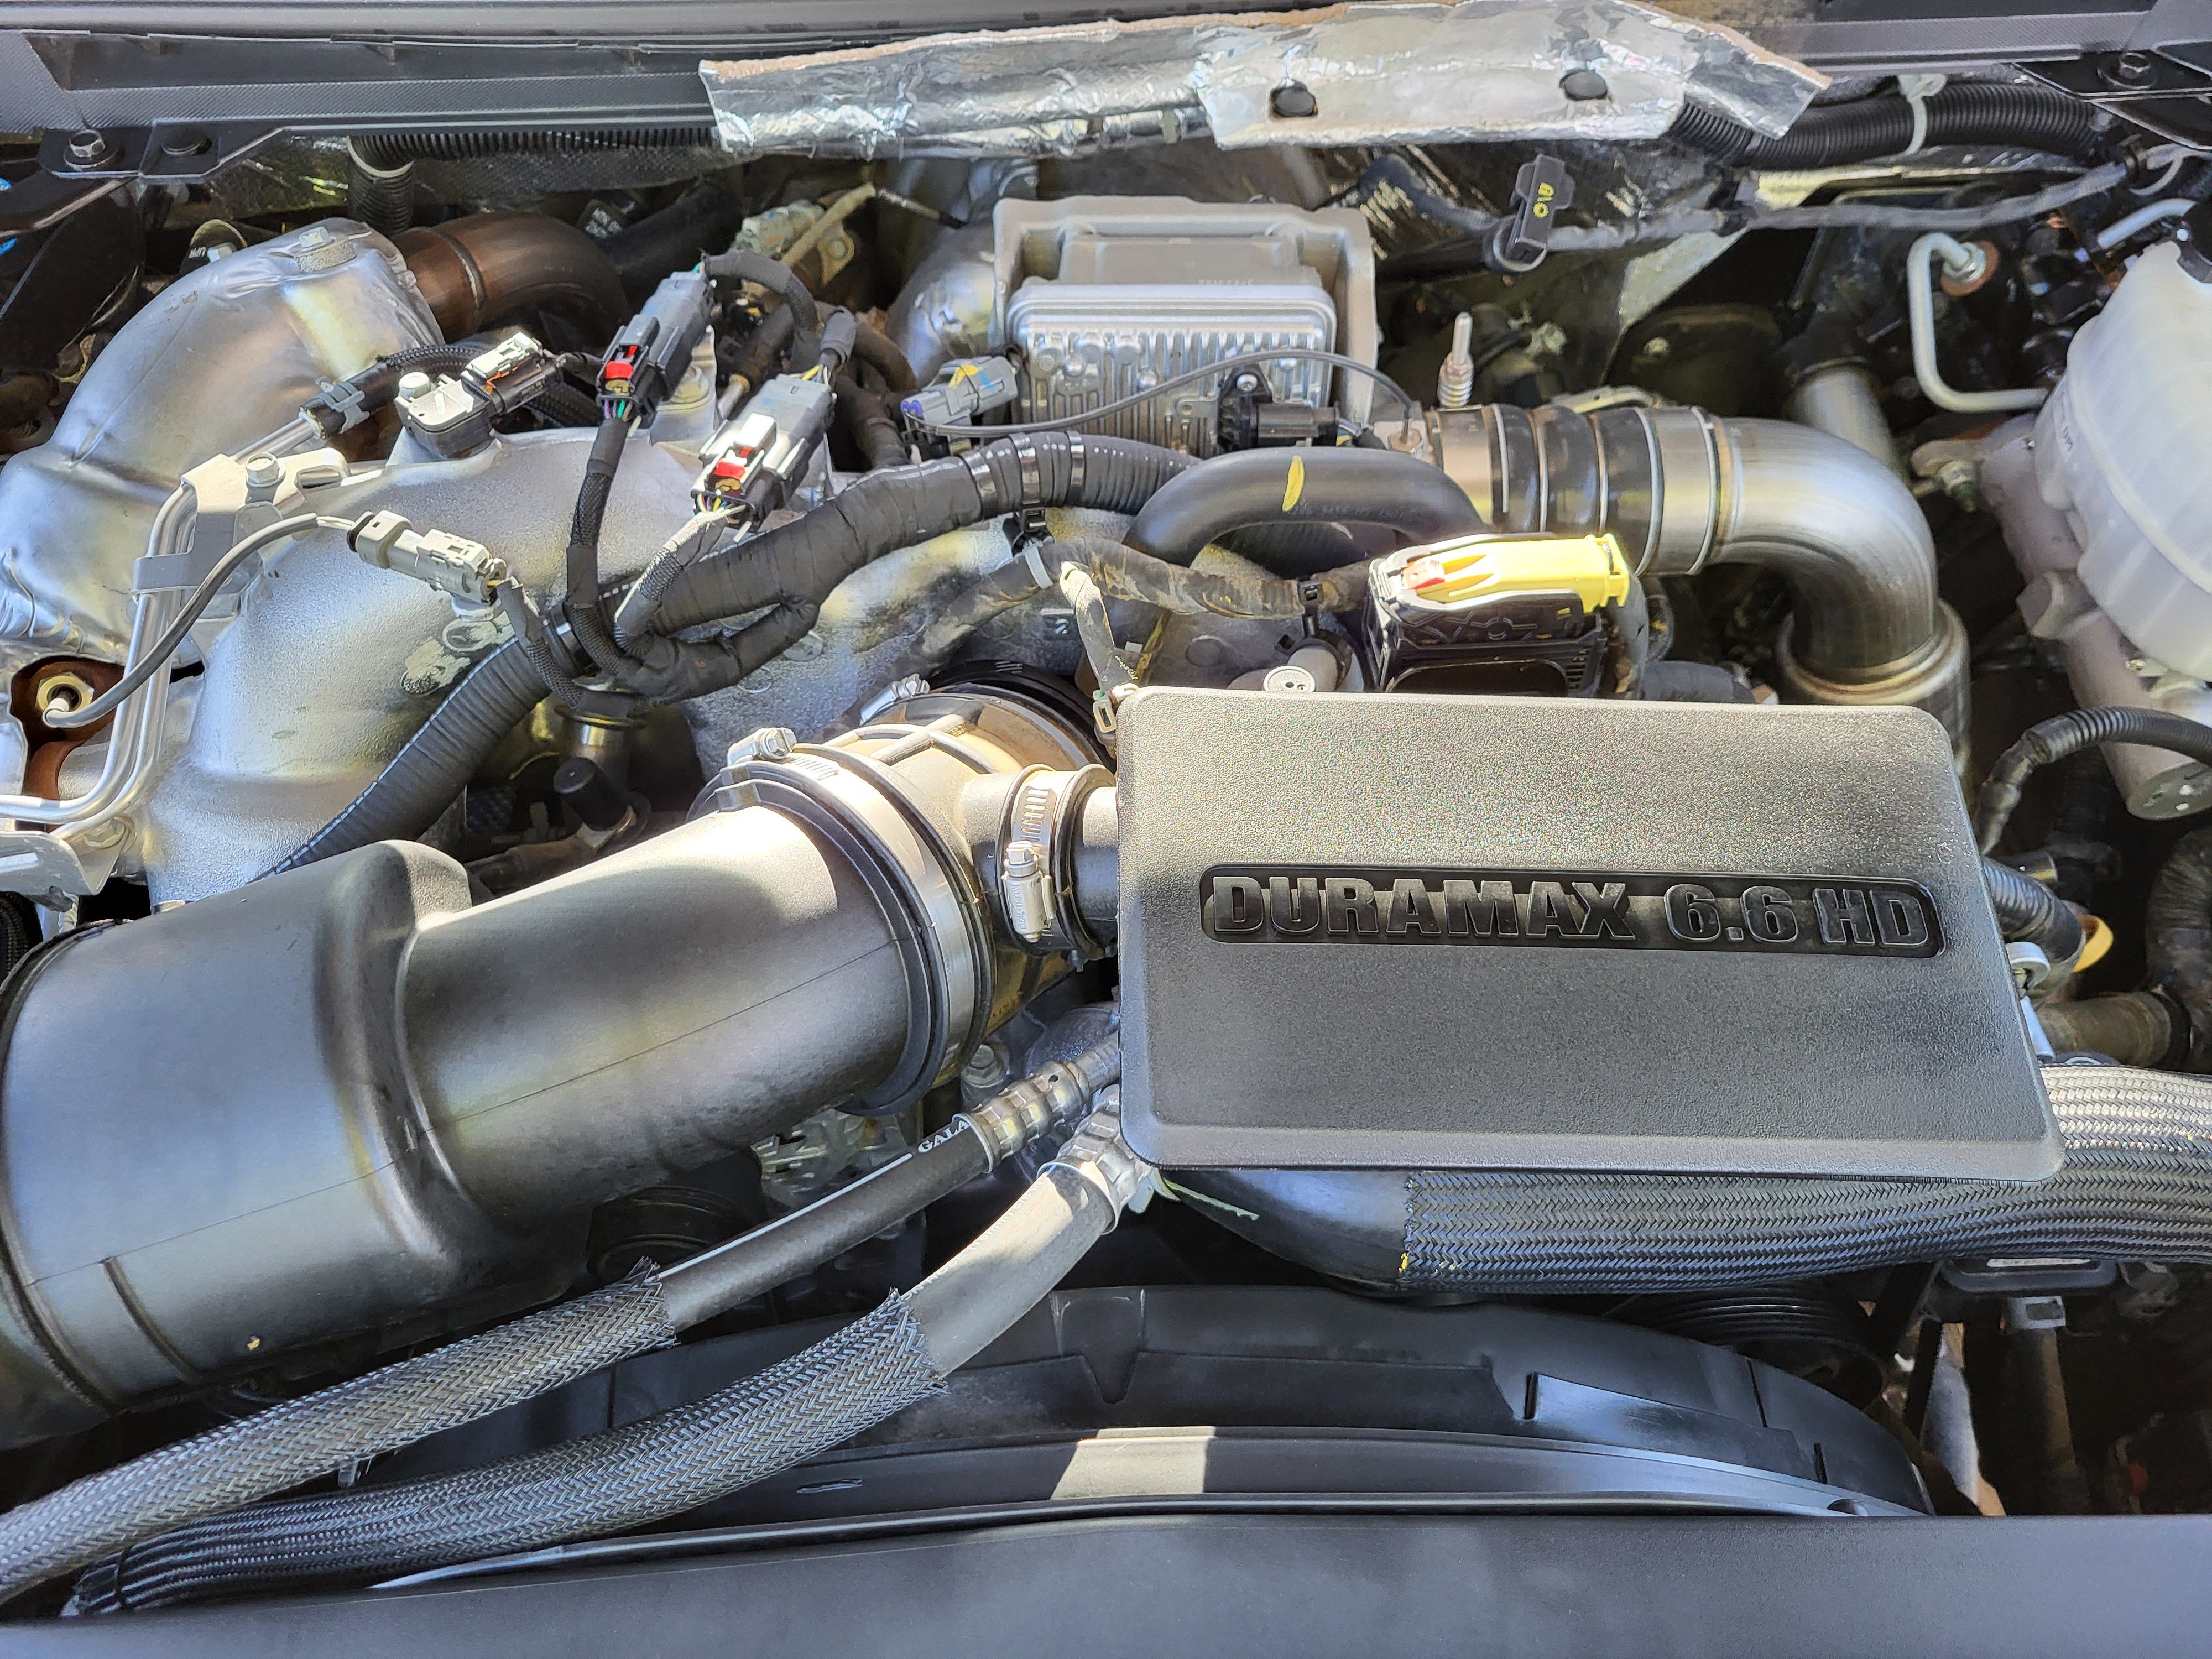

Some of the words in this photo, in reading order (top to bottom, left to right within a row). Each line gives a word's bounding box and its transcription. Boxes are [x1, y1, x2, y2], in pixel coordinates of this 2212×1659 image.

[1212, 875, 1637, 942] DURAMAX
[1663, 884, 1801, 946] 6.6
[1811, 886, 1937, 950] HD
[917, 1119, 971, 1154] GALA
